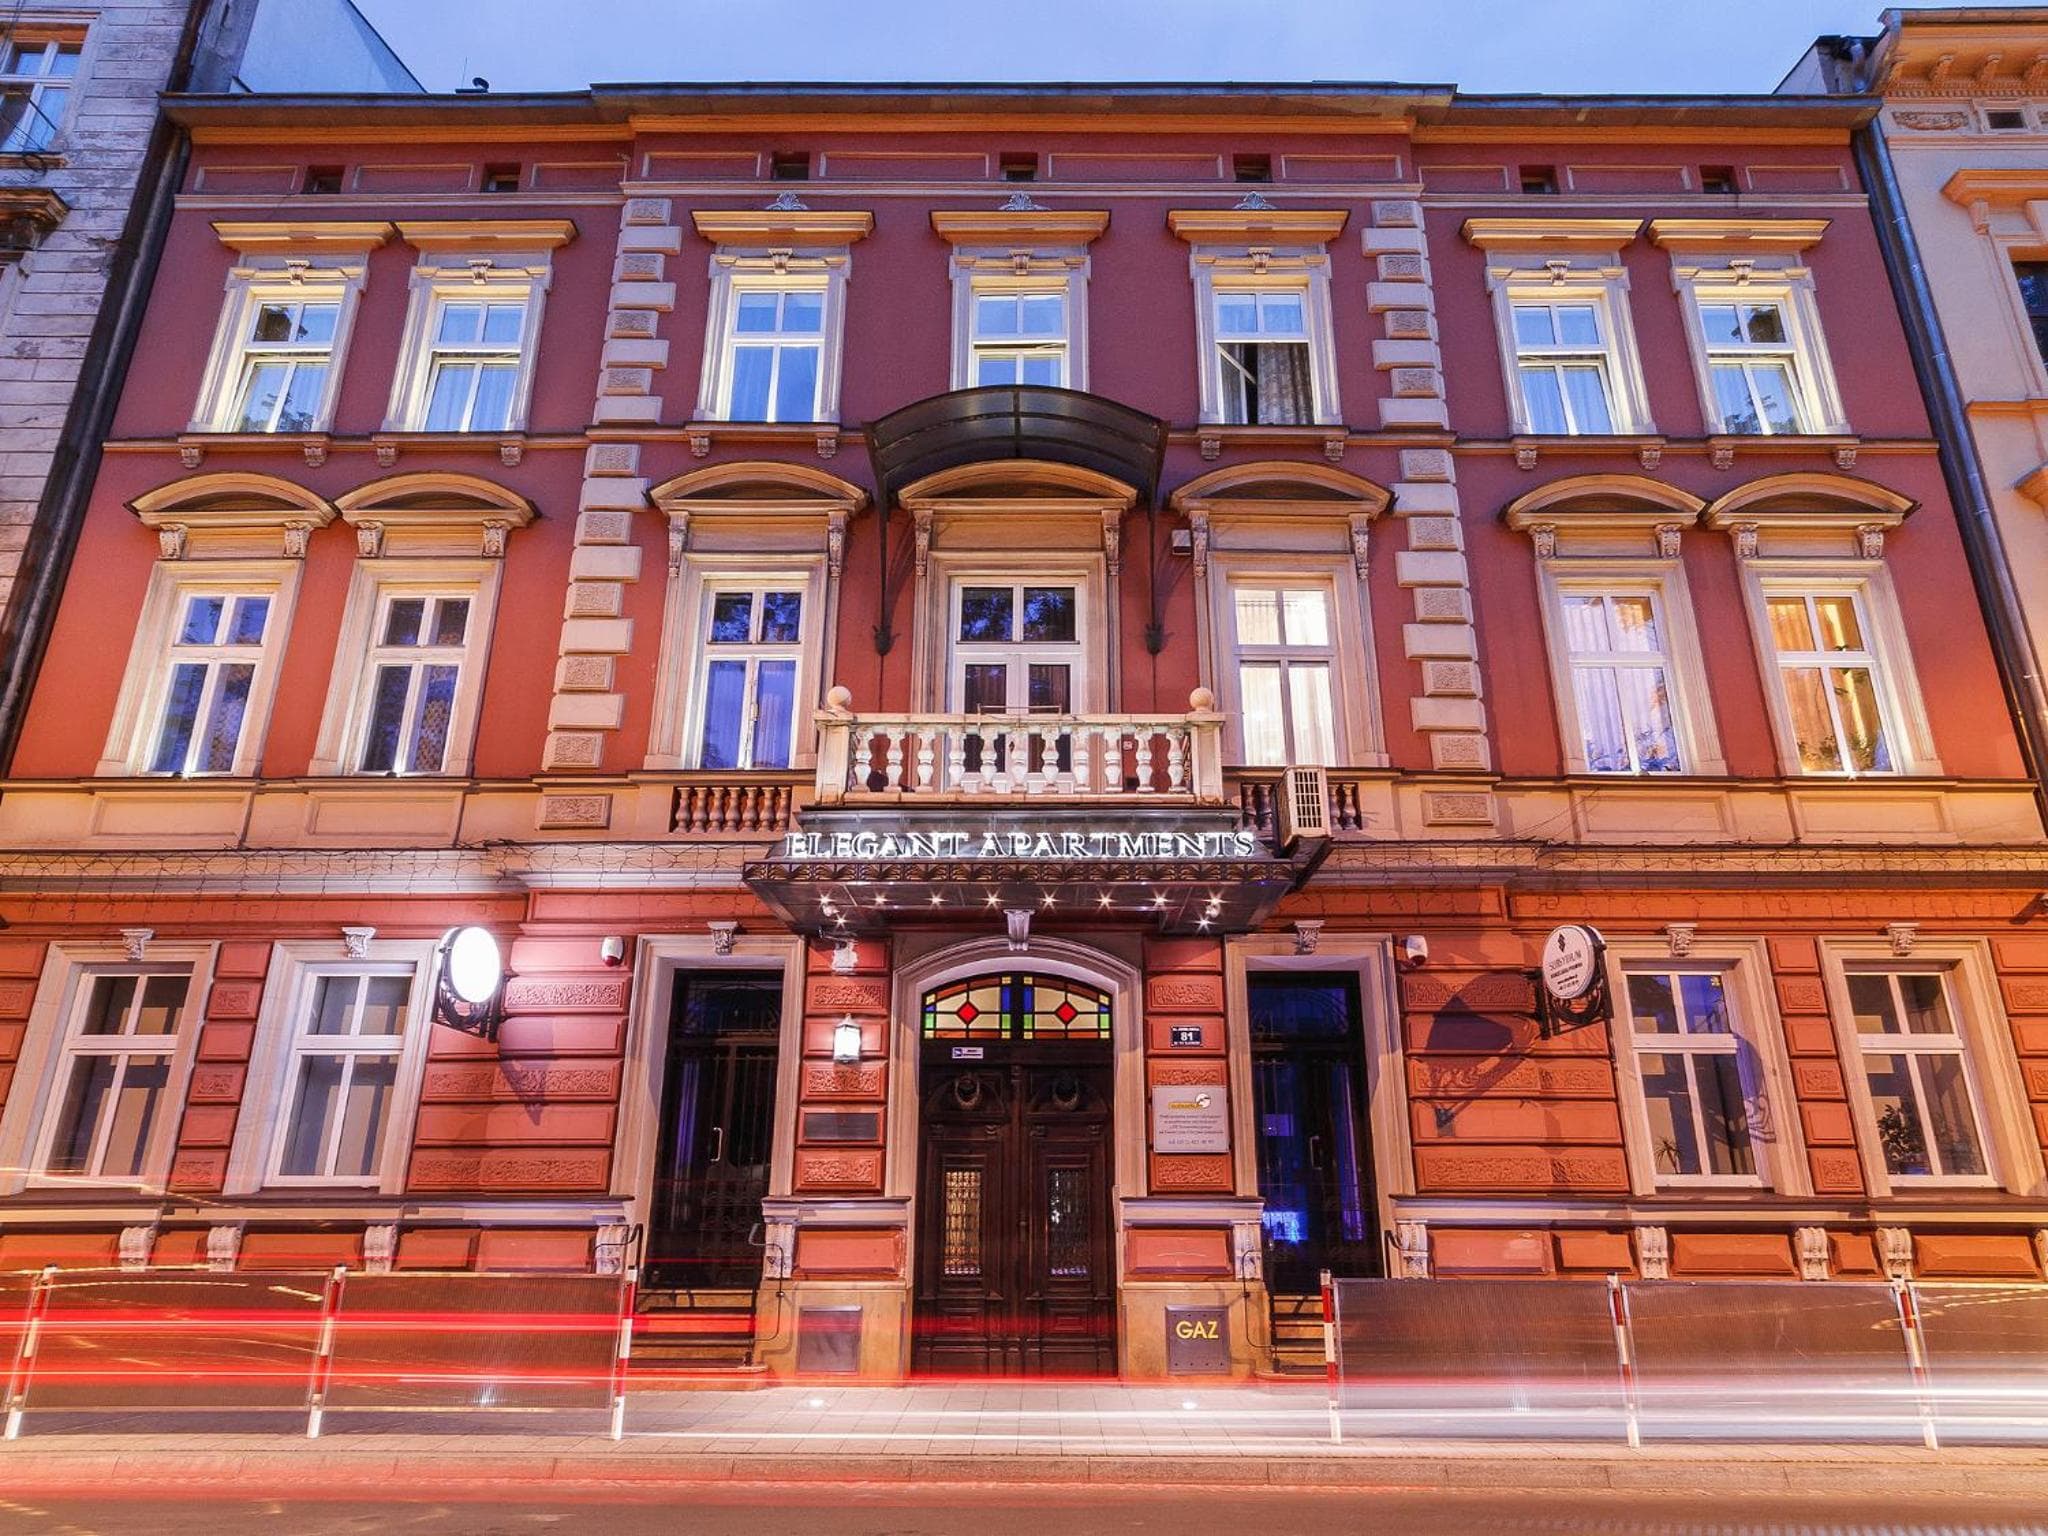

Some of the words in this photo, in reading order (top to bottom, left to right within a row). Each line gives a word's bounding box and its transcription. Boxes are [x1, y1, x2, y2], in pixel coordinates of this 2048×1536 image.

[784, 832, 969, 858] ELEGANT
[977, 832, 1254, 858] APARTMENTS
[1180, 1031, 1193, 1041] 81
[1176, 1320, 1219, 1339] GAZ
